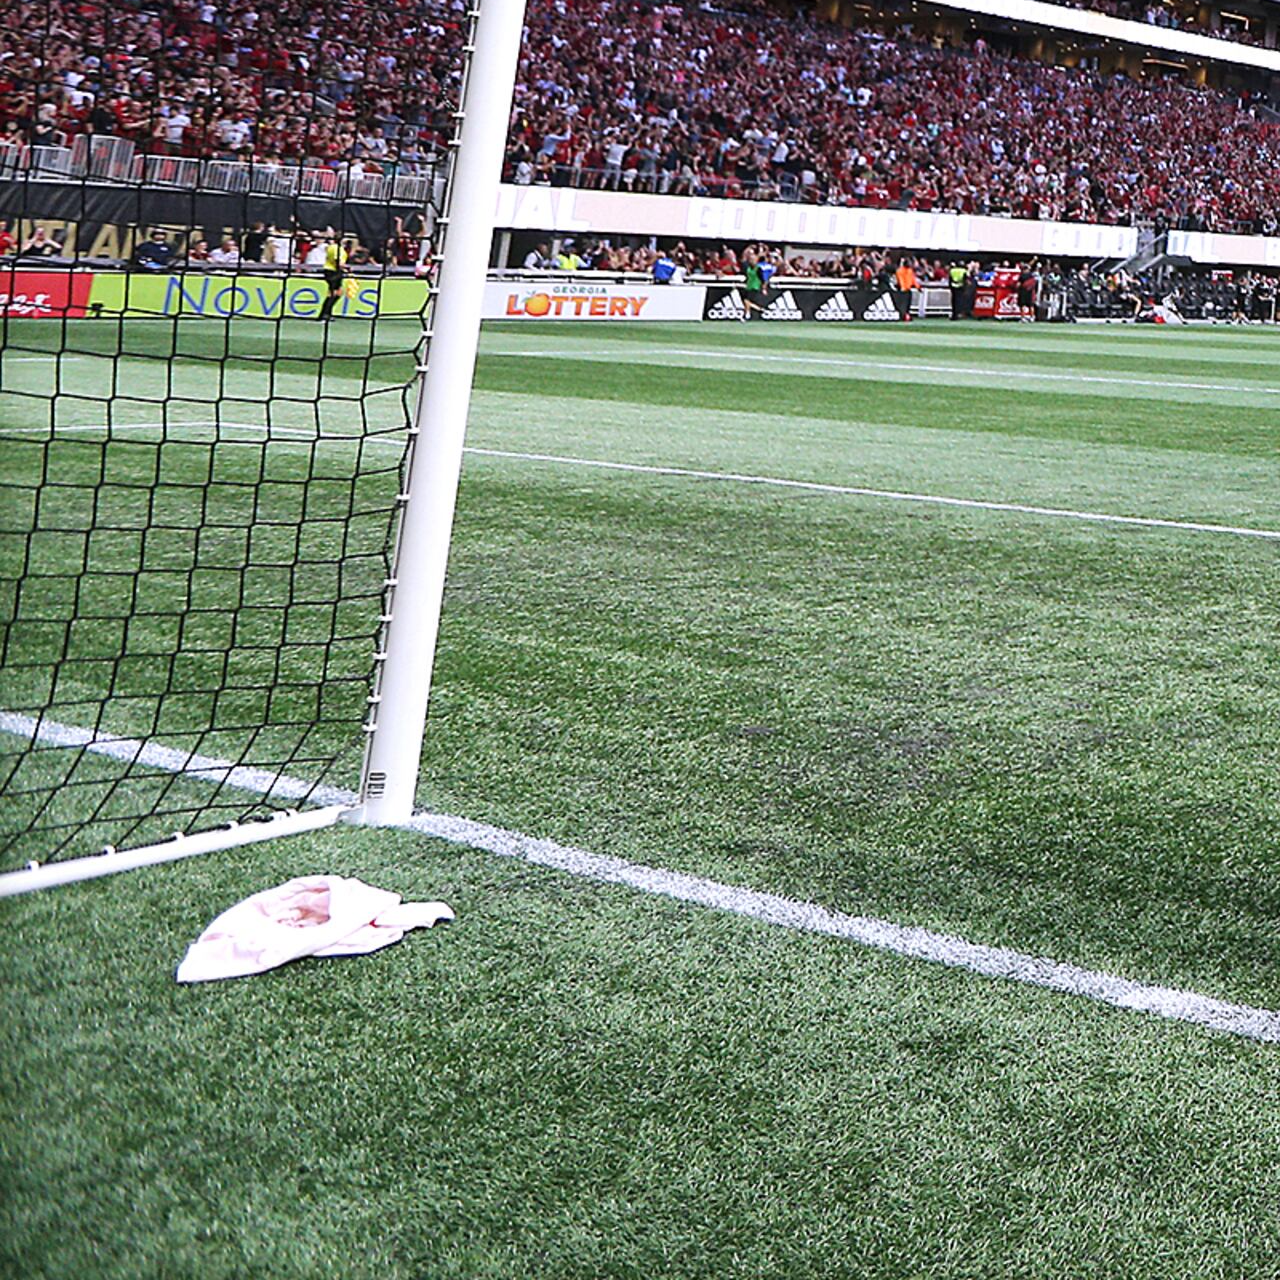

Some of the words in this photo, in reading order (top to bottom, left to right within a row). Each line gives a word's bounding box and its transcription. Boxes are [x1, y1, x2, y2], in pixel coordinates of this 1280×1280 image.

[162, 277, 381, 317] Noveis
[552, 286, 607, 295] GEORGIA
[506, 294, 649, 317] LOTTERY
